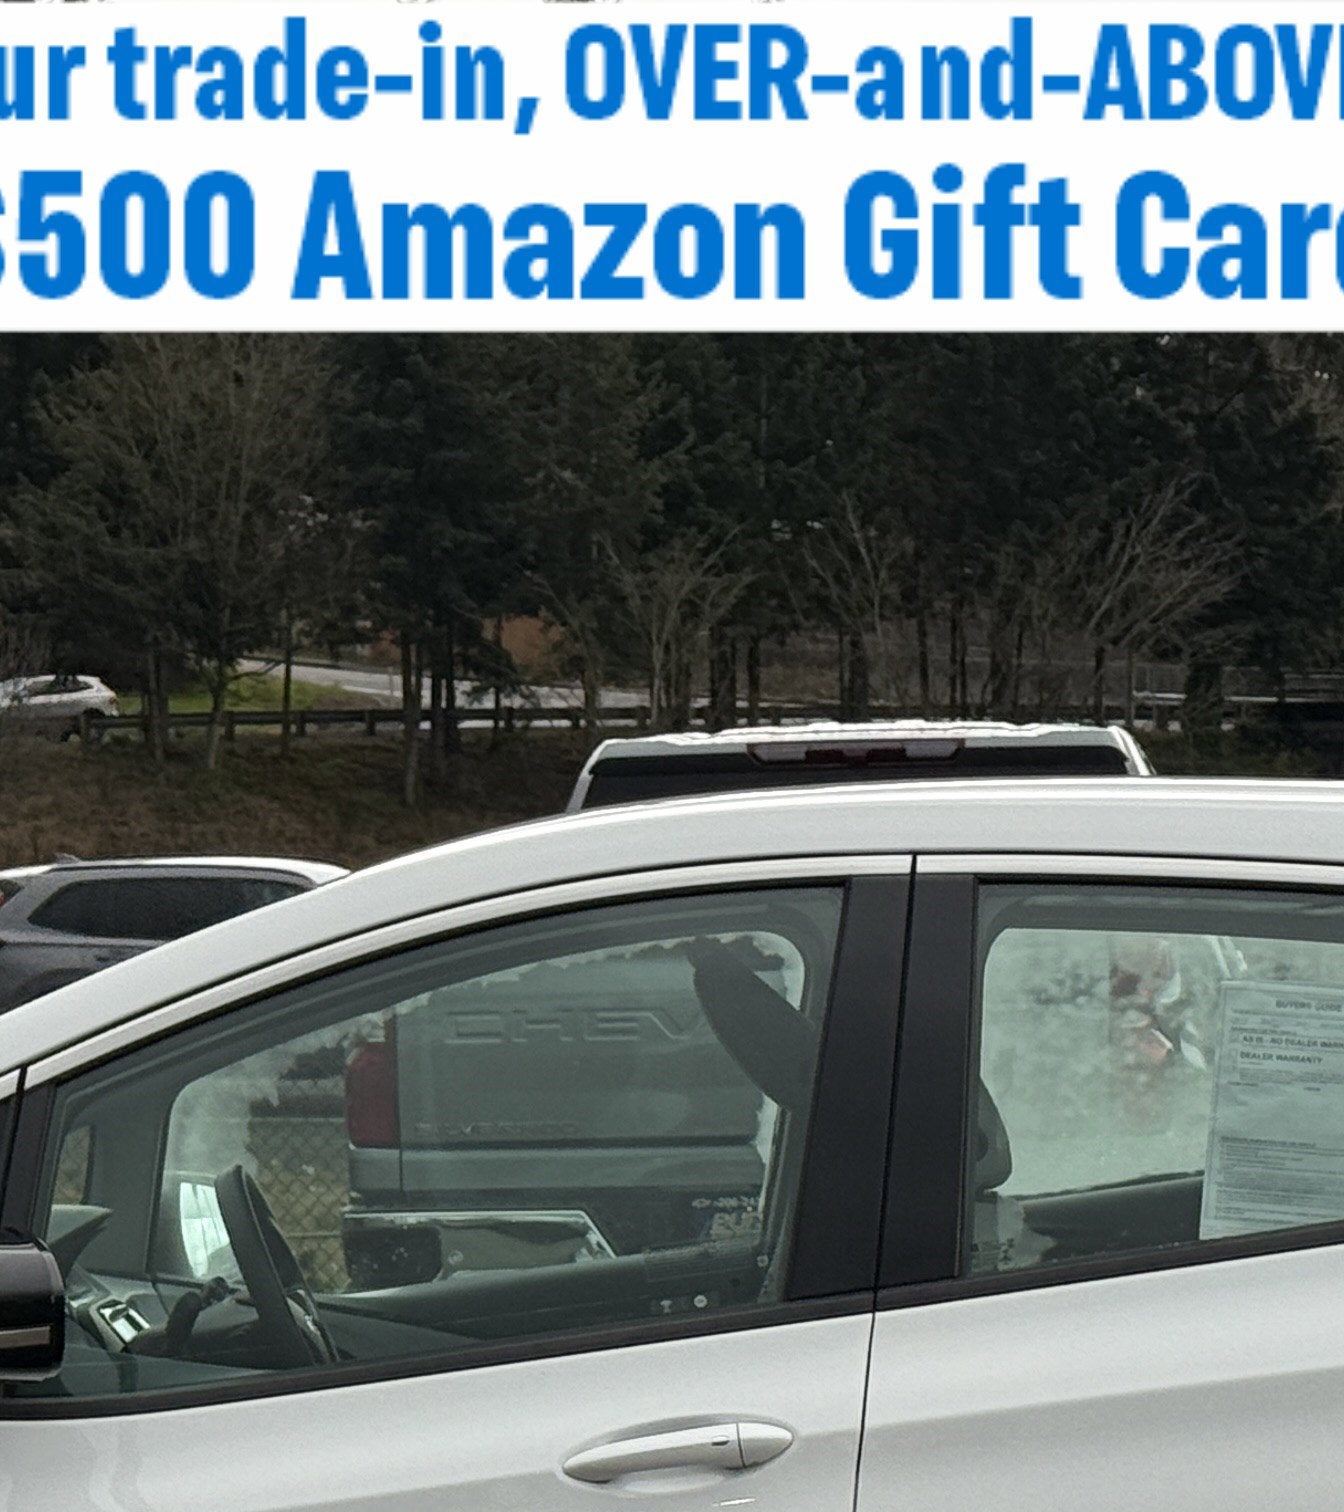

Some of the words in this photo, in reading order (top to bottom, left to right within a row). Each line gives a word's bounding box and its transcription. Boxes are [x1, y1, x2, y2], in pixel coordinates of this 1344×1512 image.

[1285, 1038, 1319, 1048] DEALER
[1240, 1051, 1274, 1062] DEALER
[1276, 1052, 1324, 1064] WARRANTY
